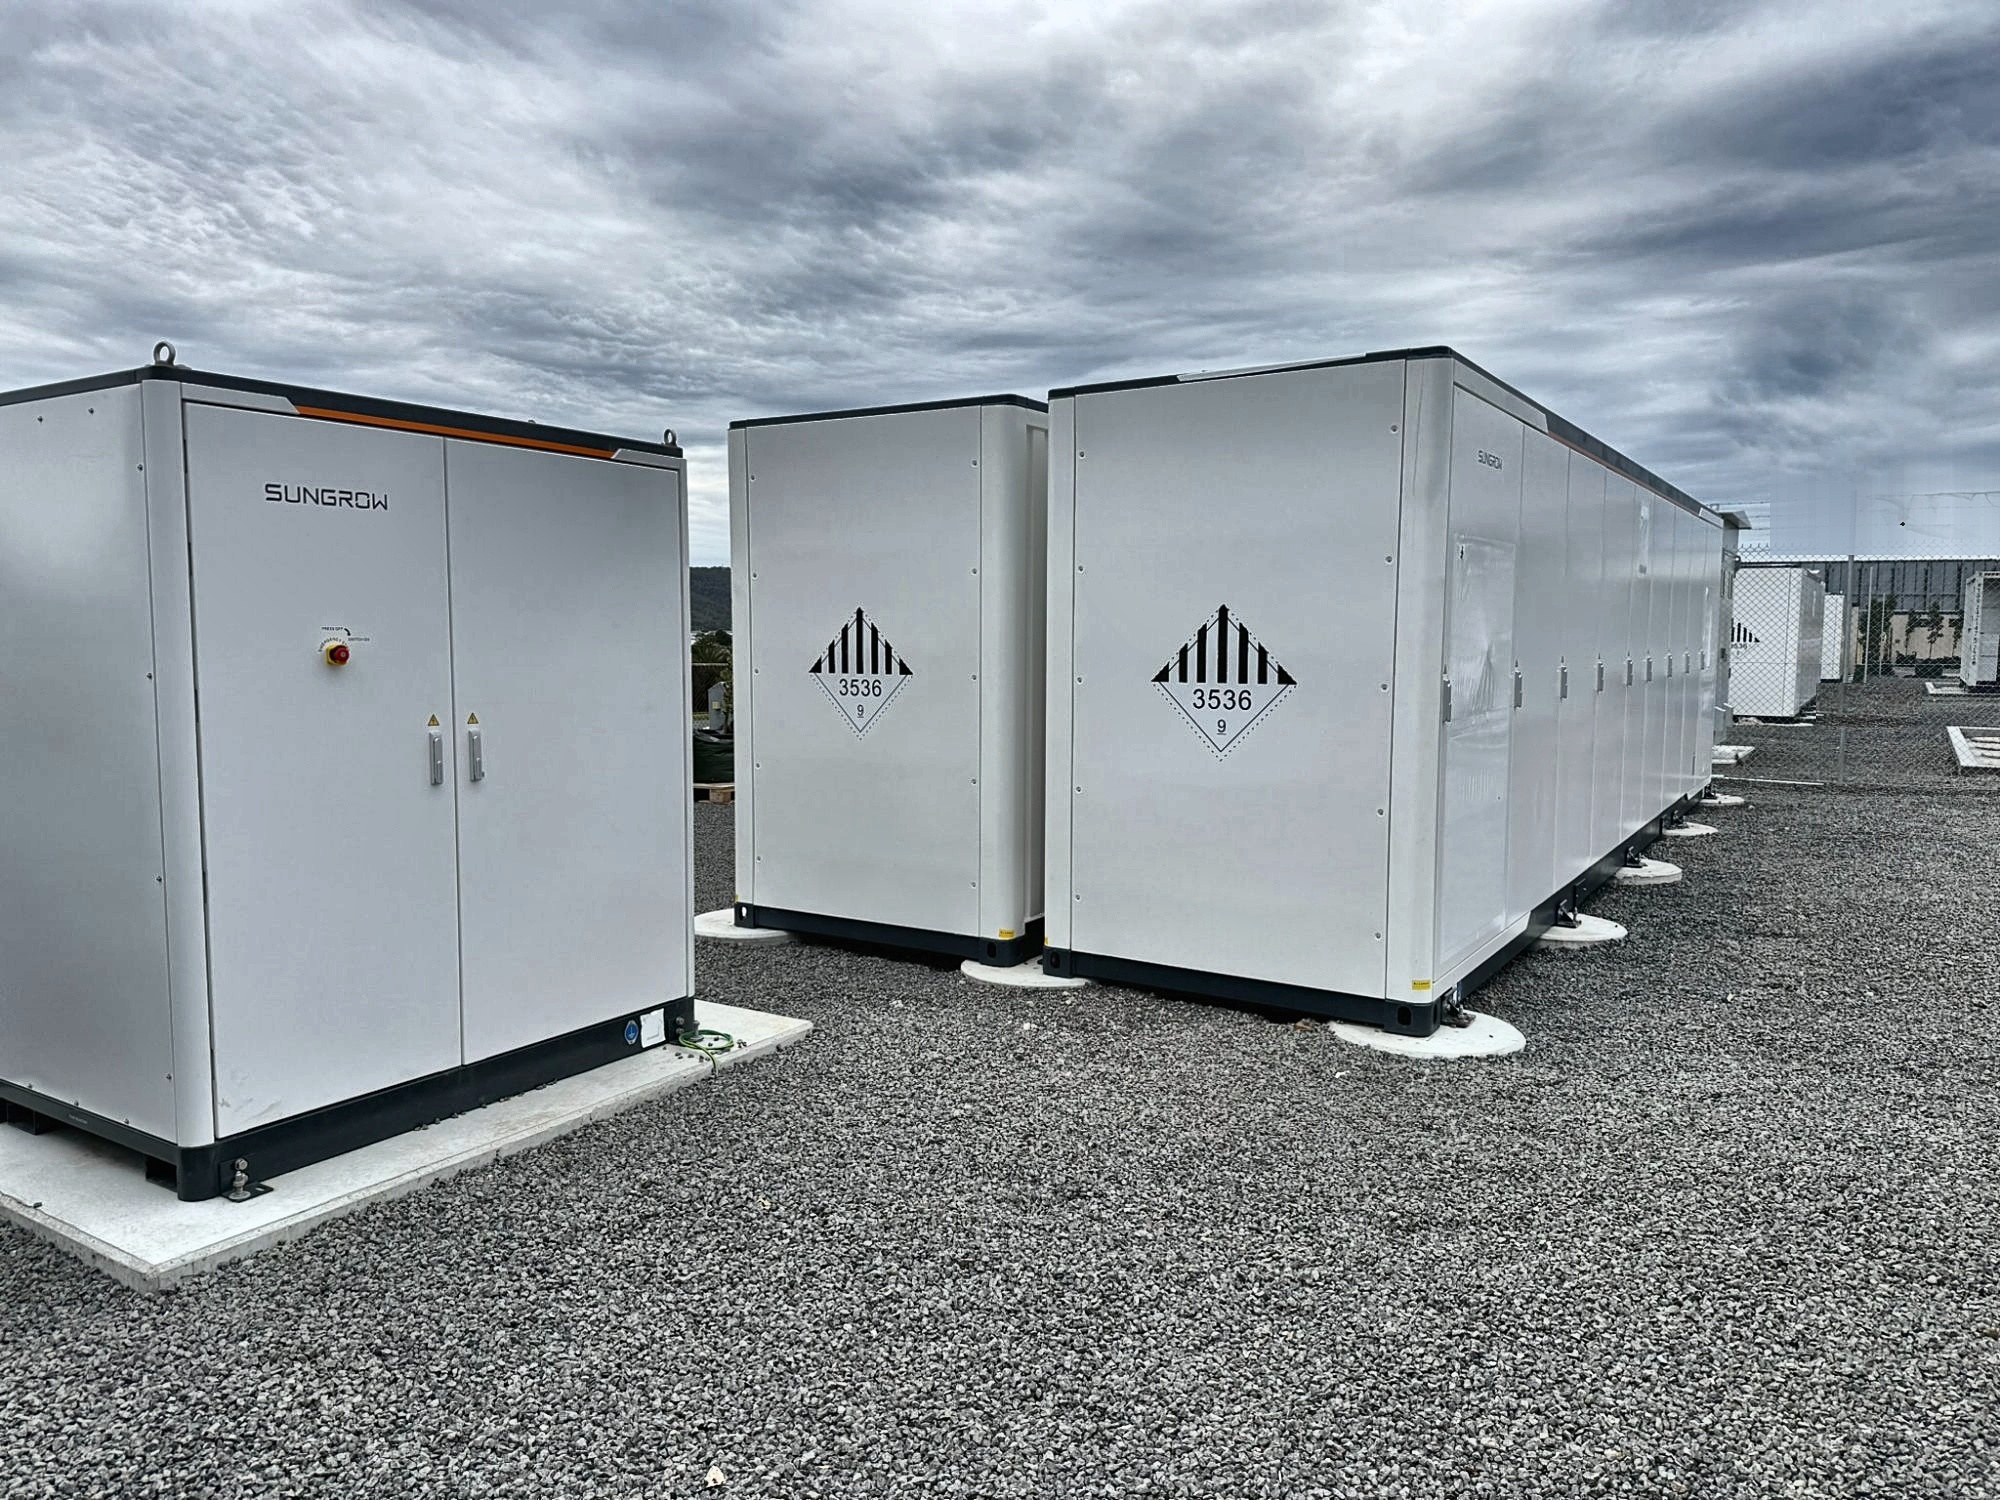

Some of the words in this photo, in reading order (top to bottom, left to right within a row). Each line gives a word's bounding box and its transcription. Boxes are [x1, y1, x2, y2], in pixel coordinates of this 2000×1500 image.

[265, 483, 388, 511] SUNGROW
[839, 678, 882, 697] 3536
[1192, 688, 1252, 711] 3536
[856, 704, 865, 717] 9
[1216, 719, 1227, 734] 9
